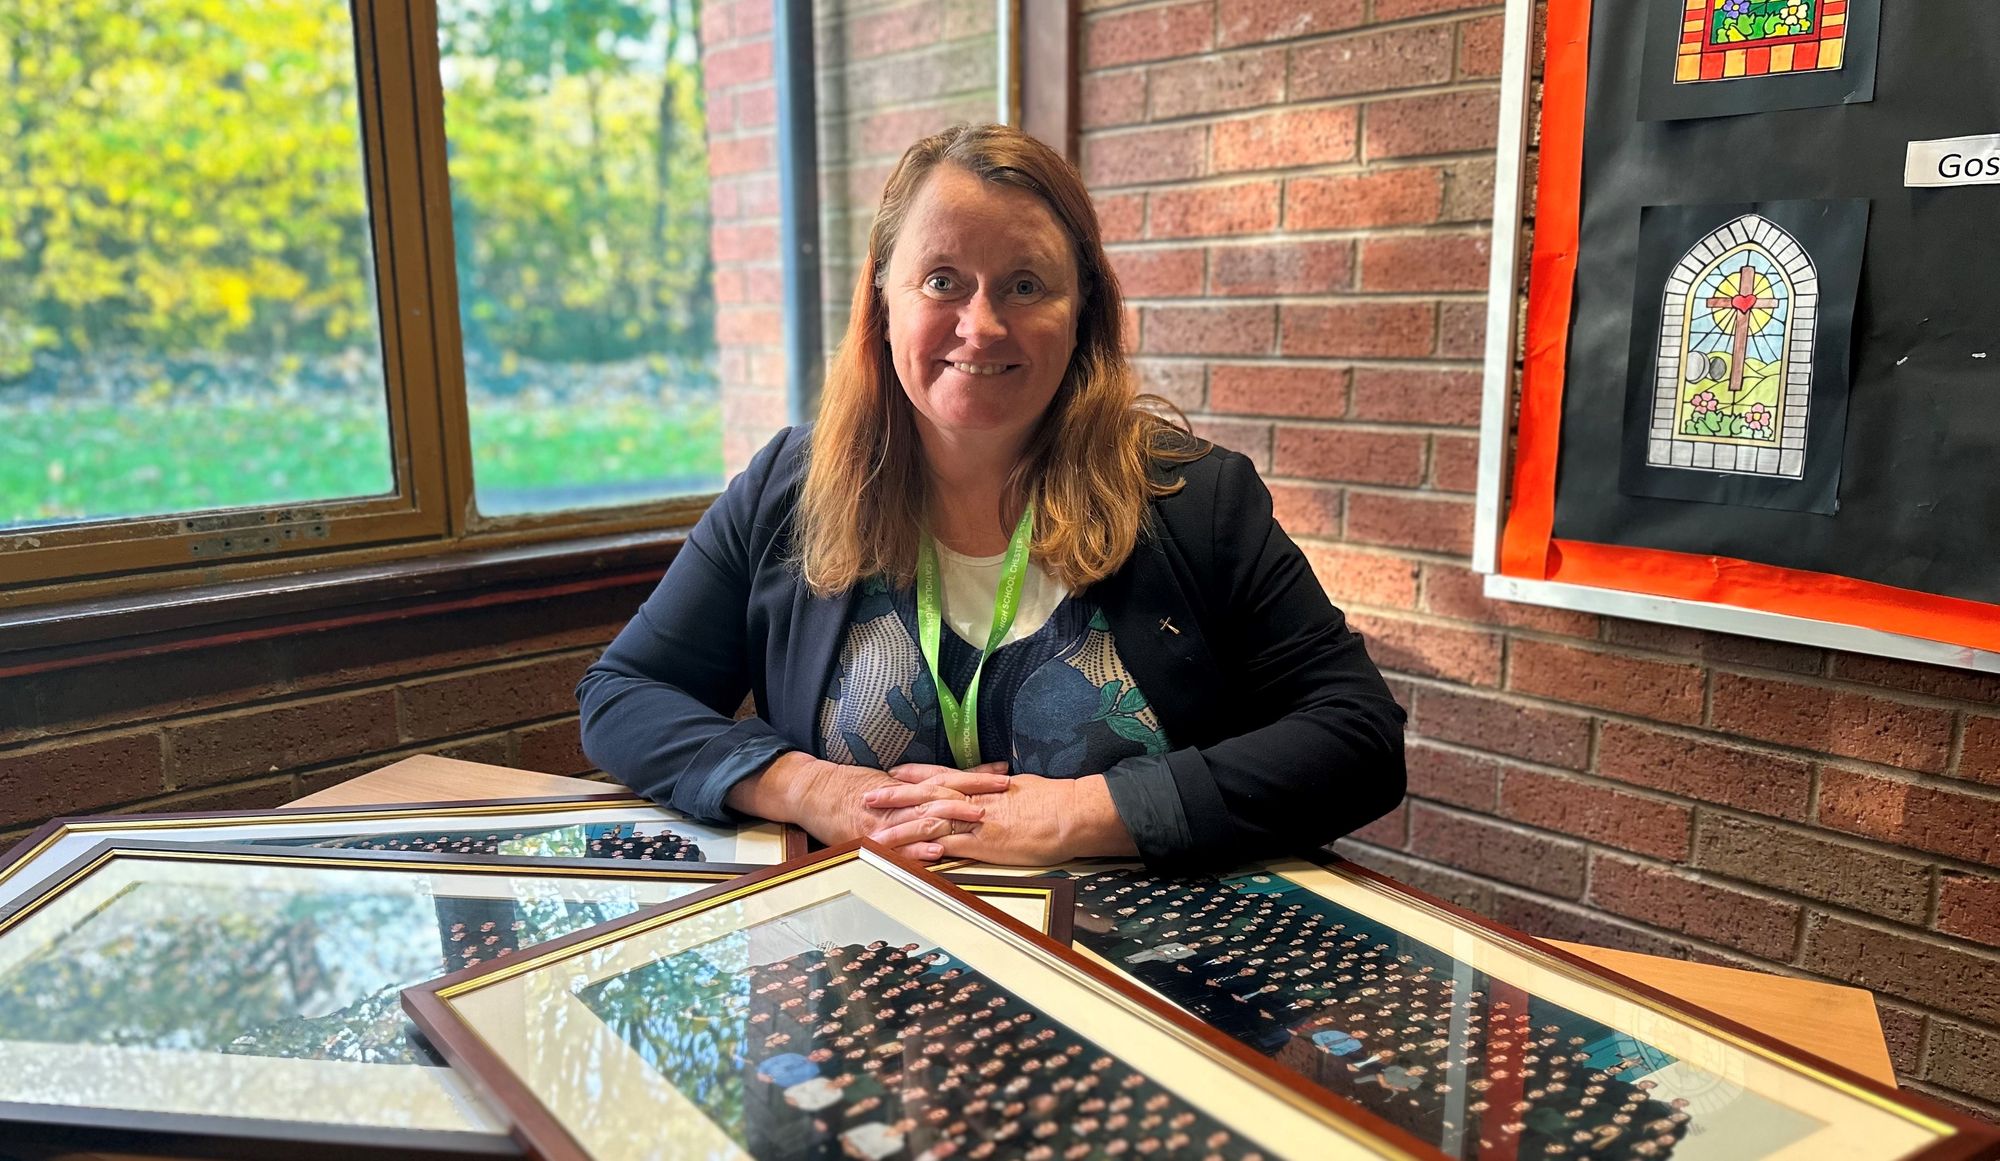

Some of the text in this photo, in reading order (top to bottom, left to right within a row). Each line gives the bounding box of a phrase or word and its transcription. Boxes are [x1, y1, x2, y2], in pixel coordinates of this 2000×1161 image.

[1938, 153, 2000, 178] Gos
[925, 564, 933, 602] CATHOLIC
[998, 540, 1023, 632] HIGH SCHOOL CHESTER
[925, 604, 934, 625] HIGH
[944, 695, 955, 710] THE
[963, 726, 973, 757] SCHOOL
